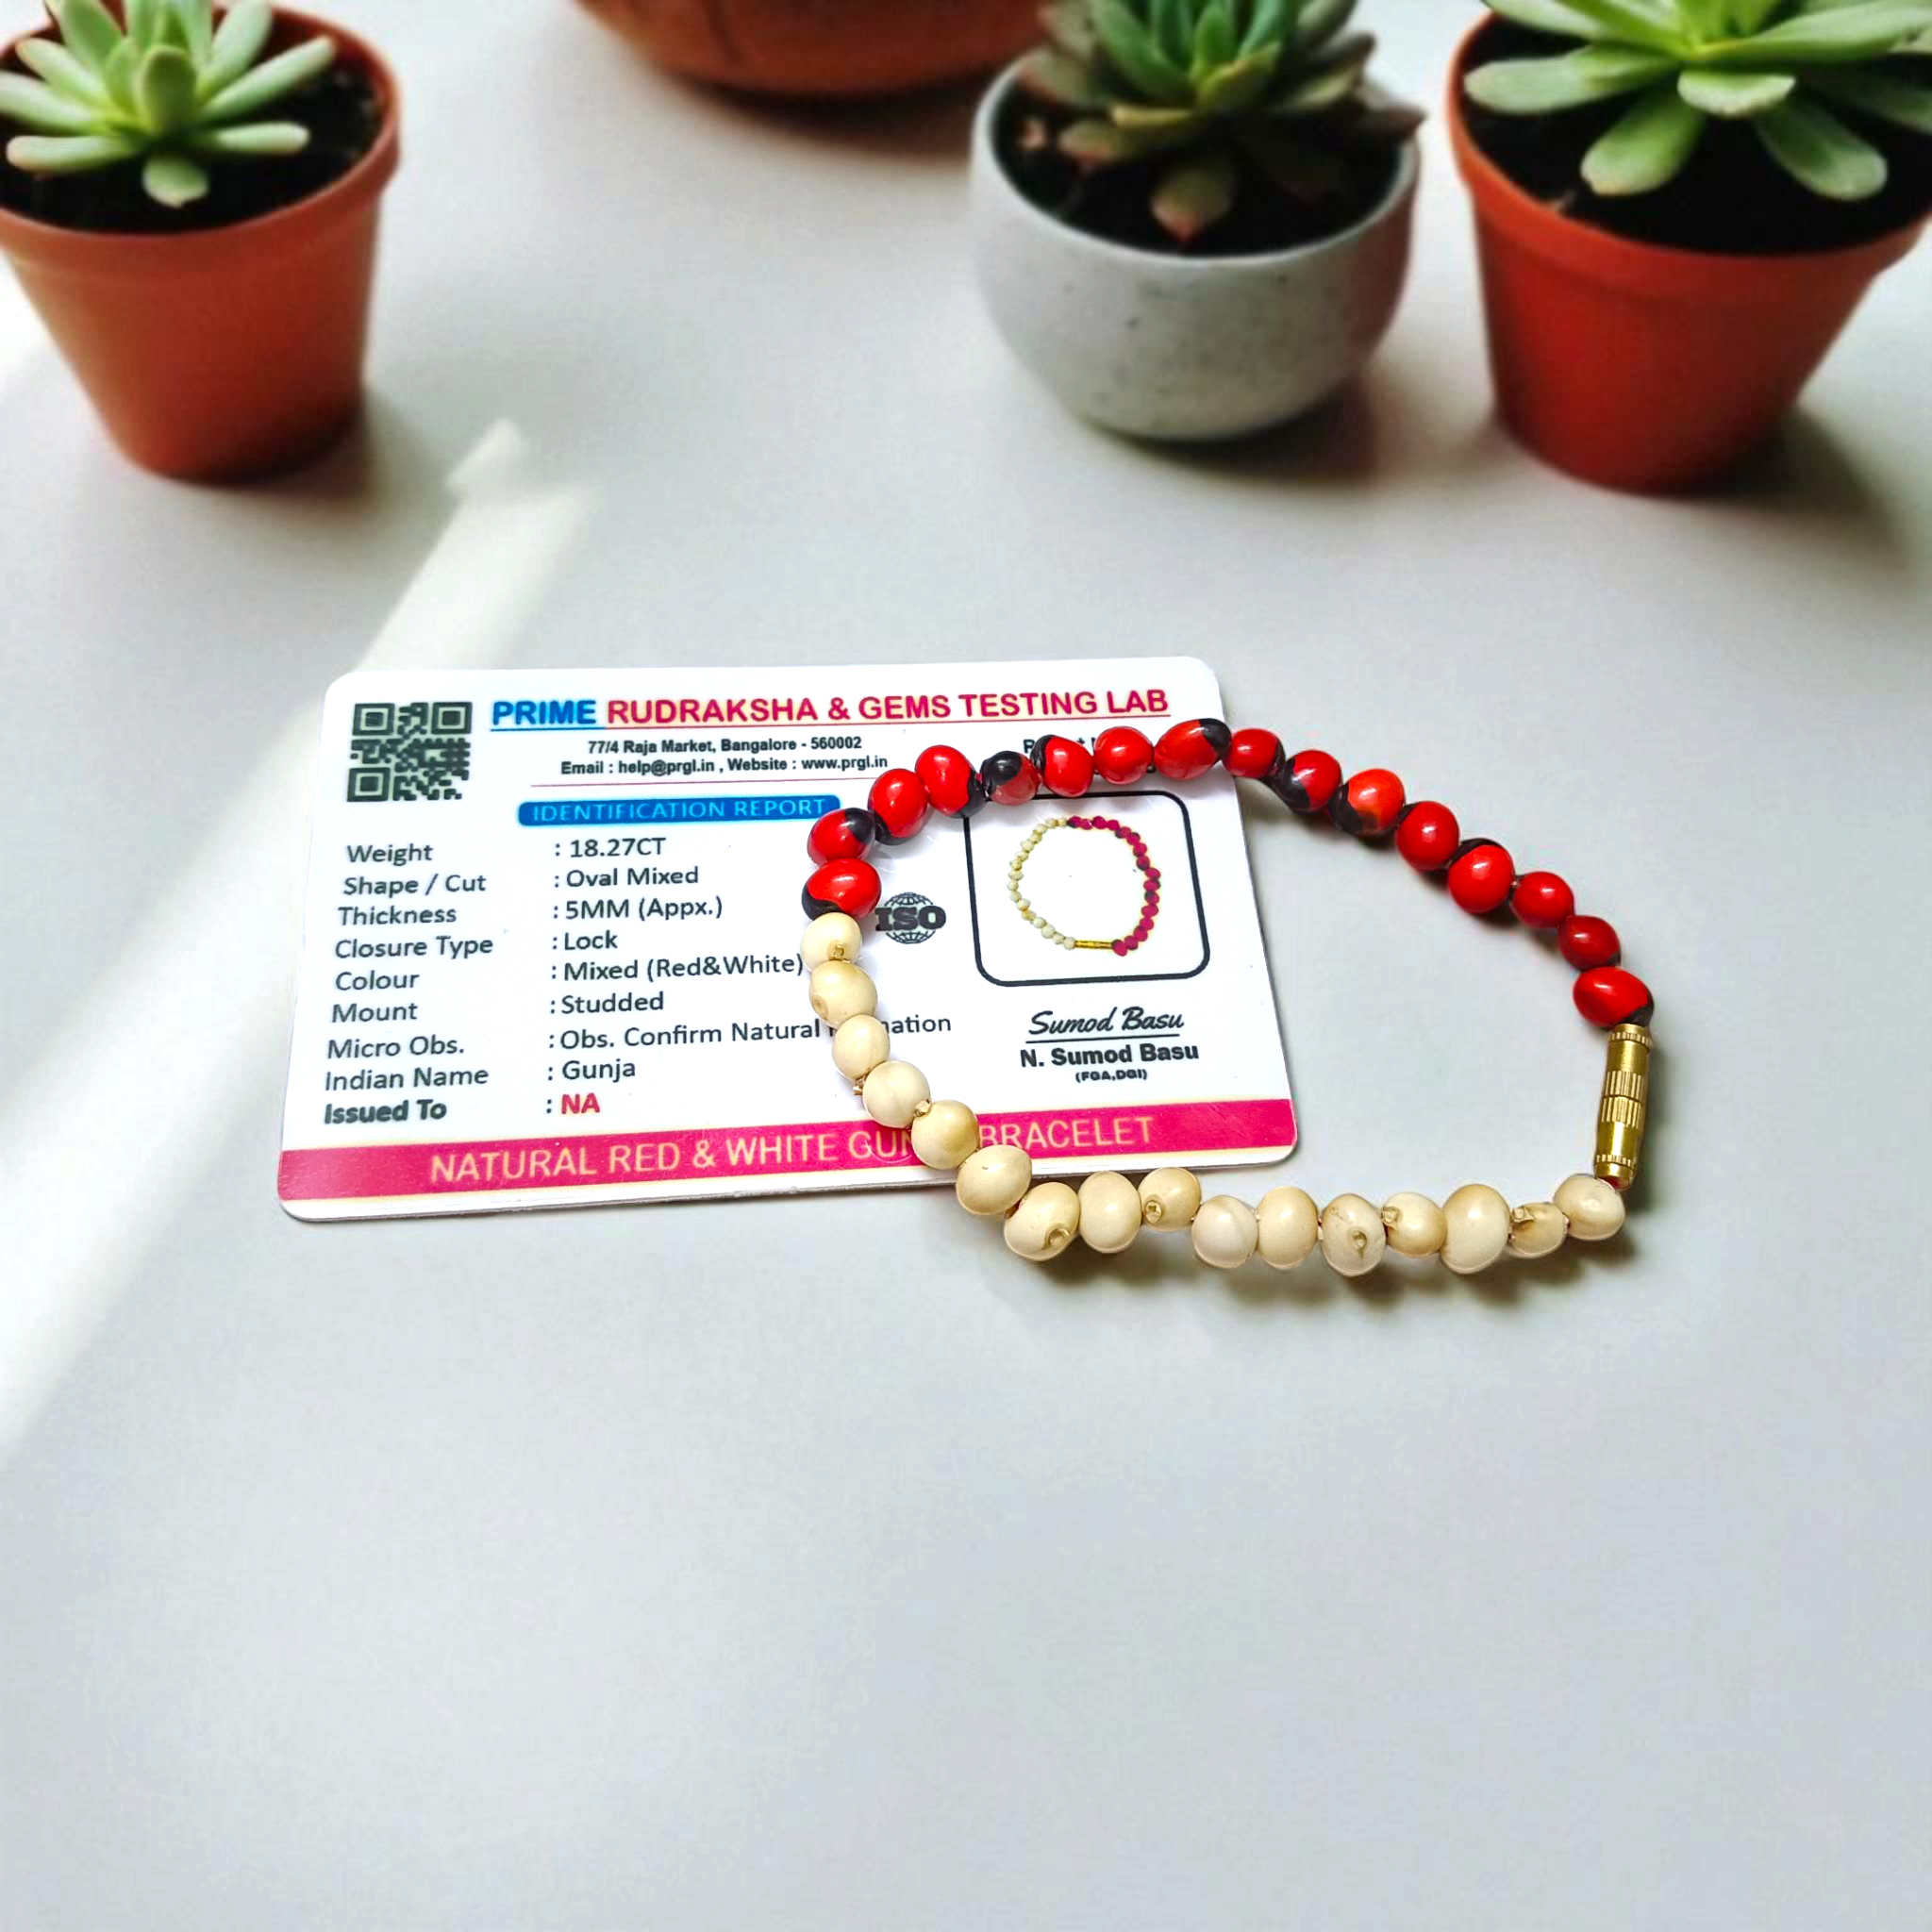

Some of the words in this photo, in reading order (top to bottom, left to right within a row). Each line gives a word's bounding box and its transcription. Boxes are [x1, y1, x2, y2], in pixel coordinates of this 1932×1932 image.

[492, 700, 596, 725] PRIME
[607, 698, 819, 724] RUDRAKSHA
[827, 697, 852, 721] &
[858, 695, 951, 719] GEMS
[958, 691, 1097, 717] TESTING
[1107, 689, 1169, 713] LAB
[588, 741, 619, 754] 77/4
[624, 740, 658, 757] Raja
[661, 739, 716, 754] Market,
[721, 738, 797, 754] Bangalore
[810, 736, 862, 749] 560002
[560, 759, 604, 774] Email
[618, 758, 715, 776] help@prgl.in
[727, 757, 788, 772] Website
[801, 756, 888, 772] www.prgl.in
[533, 801, 724, 821] IDENTIFICATION
[735, 799, 825, 817] REPORT
[346, 843, 434, 866] Weight
[570, 837, 667, 858] 18.27CT
[343, 876, 419, 898] Shape
[425, 874, 440, 896] /
[445, 874, 487, 892] Cut
[566, 867, 618, 888] Oval
[626, 865, 699, 886] Mixed
[338, 905, 458, 926] Thickness
[565, 899, 629, 920] 5MM
[639, 895, 723, 922] (Appx.)
[874, 905, 947, 932] ISO
[335, 938, 427, 958] Closure
[436, 935, 493, 959] Type
[564, 929, 618, 951] Lock
[335, 970, 420, 991] Colour
[564, 959, 639, 981] Mixed
[647, 953, 803, 983] (Red&White)
[331, 1002, 418, 1023] Mount
[560, 991, 664, 1014] Studded
[1028, 1007, 1118, 1035] Sumod
[1122, 1006, 1185, 1031] Basu
[327, 1038, 401, 1059] Micro
[408, 1034, 465, 1056] Obs.
[560, 1029, 614, 1050] Obs.
[624, 1024, 722, 1047] Confirm
[731, 1018, 821, 1041] Natural
[1020, 1049, 1044, 1068] N.
[1051, 1044, 1133, 1066] Sumod
[1139, 1042, 1200, 1062] Basu
[325, 1069, 404, 1091] Indian
[413, 1067, 490, 1088] Name
[561, 1058, 636, 1083] Gunja
[325, 1099, 409, 1124] Issued
[416, 1098, 447, 1121] To
[560, 1091, 601, 1115] NA
[430, 1147, 597, 1183] NATURAL
[609, 1141, 680, 1174] RED
[692, 1139, 716, 1169] &
[725, 1133, 838, 1167] WHITE
[979, 1115, 1154, 1149] BRACELET
